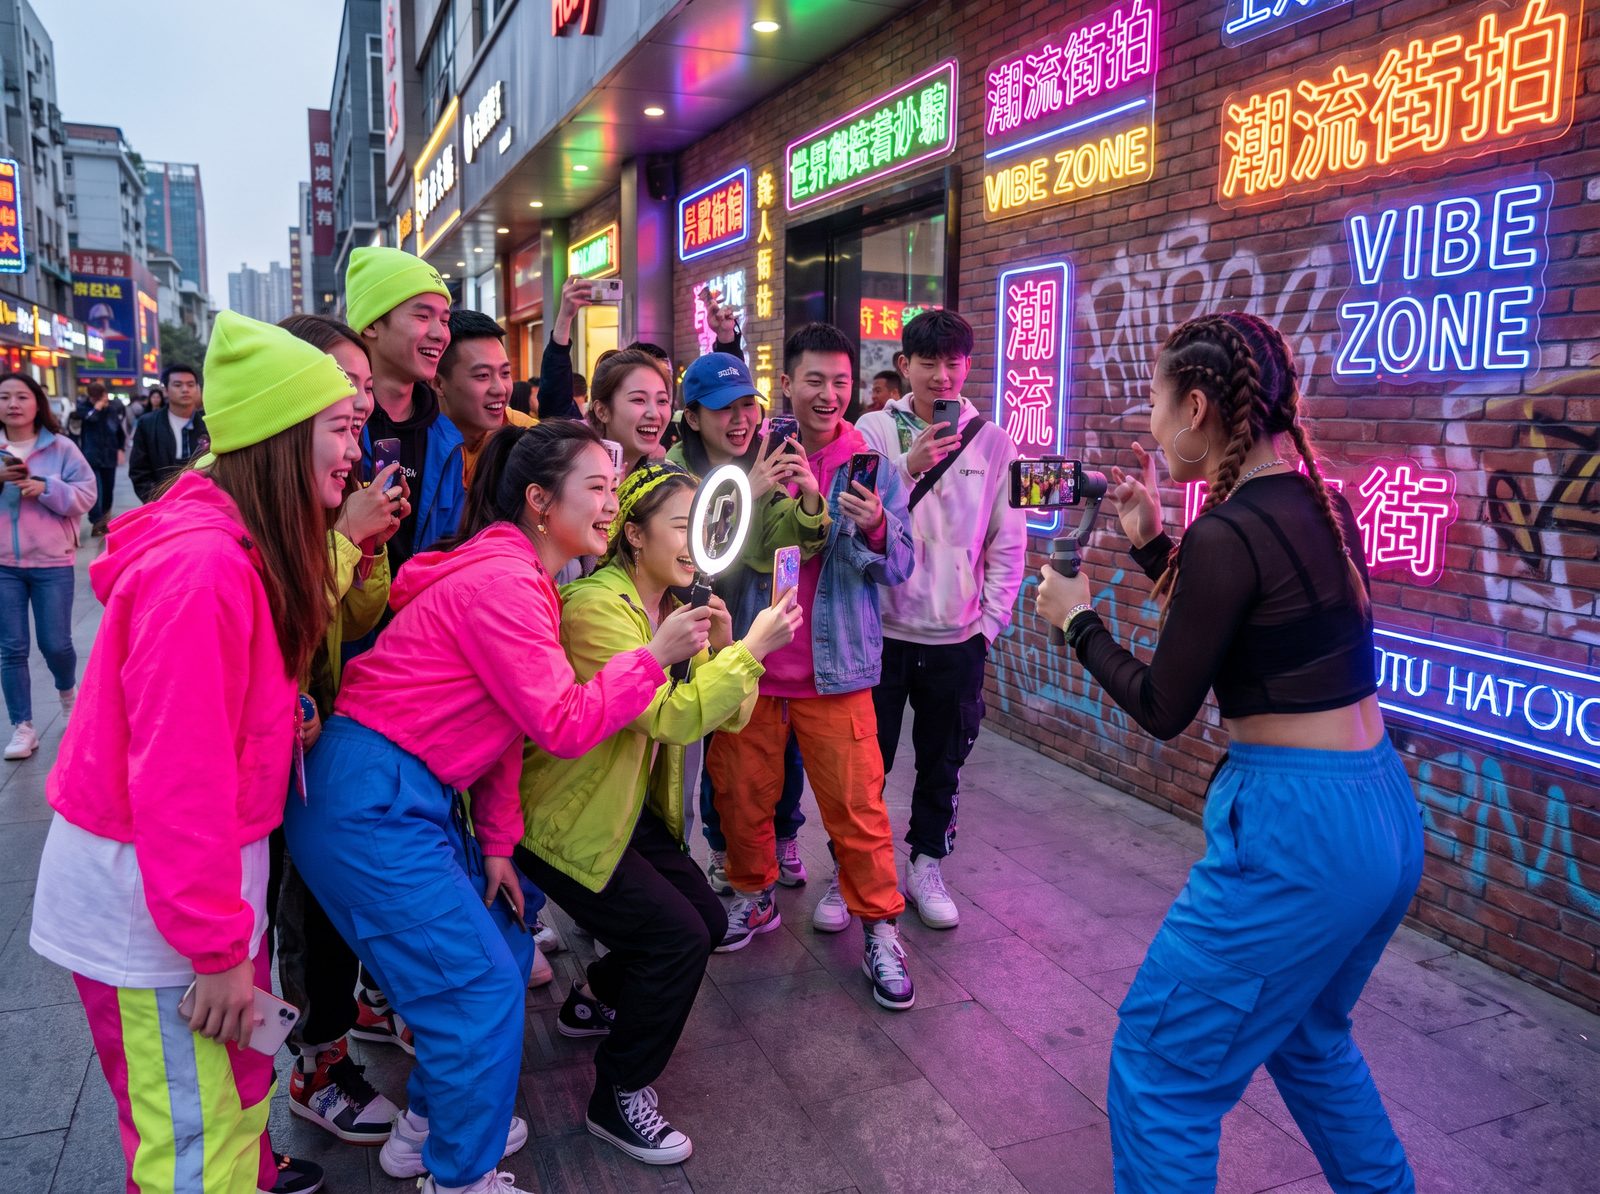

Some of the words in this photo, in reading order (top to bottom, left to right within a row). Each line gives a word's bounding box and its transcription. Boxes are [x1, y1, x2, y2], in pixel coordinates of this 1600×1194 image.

[987, 0, 1153, 135] 潮流街拍
[1223, 0, 1567, 198] 潮流街拍
[984, 157, 1049, 213] VIBE
[1053, 126, 1149, 195] ZONE
[1350, 184, 1542, 286] VIBE
[1336, 285, 1533, 375] ZONE
[1004, 279, 1057, 514] 潮流
